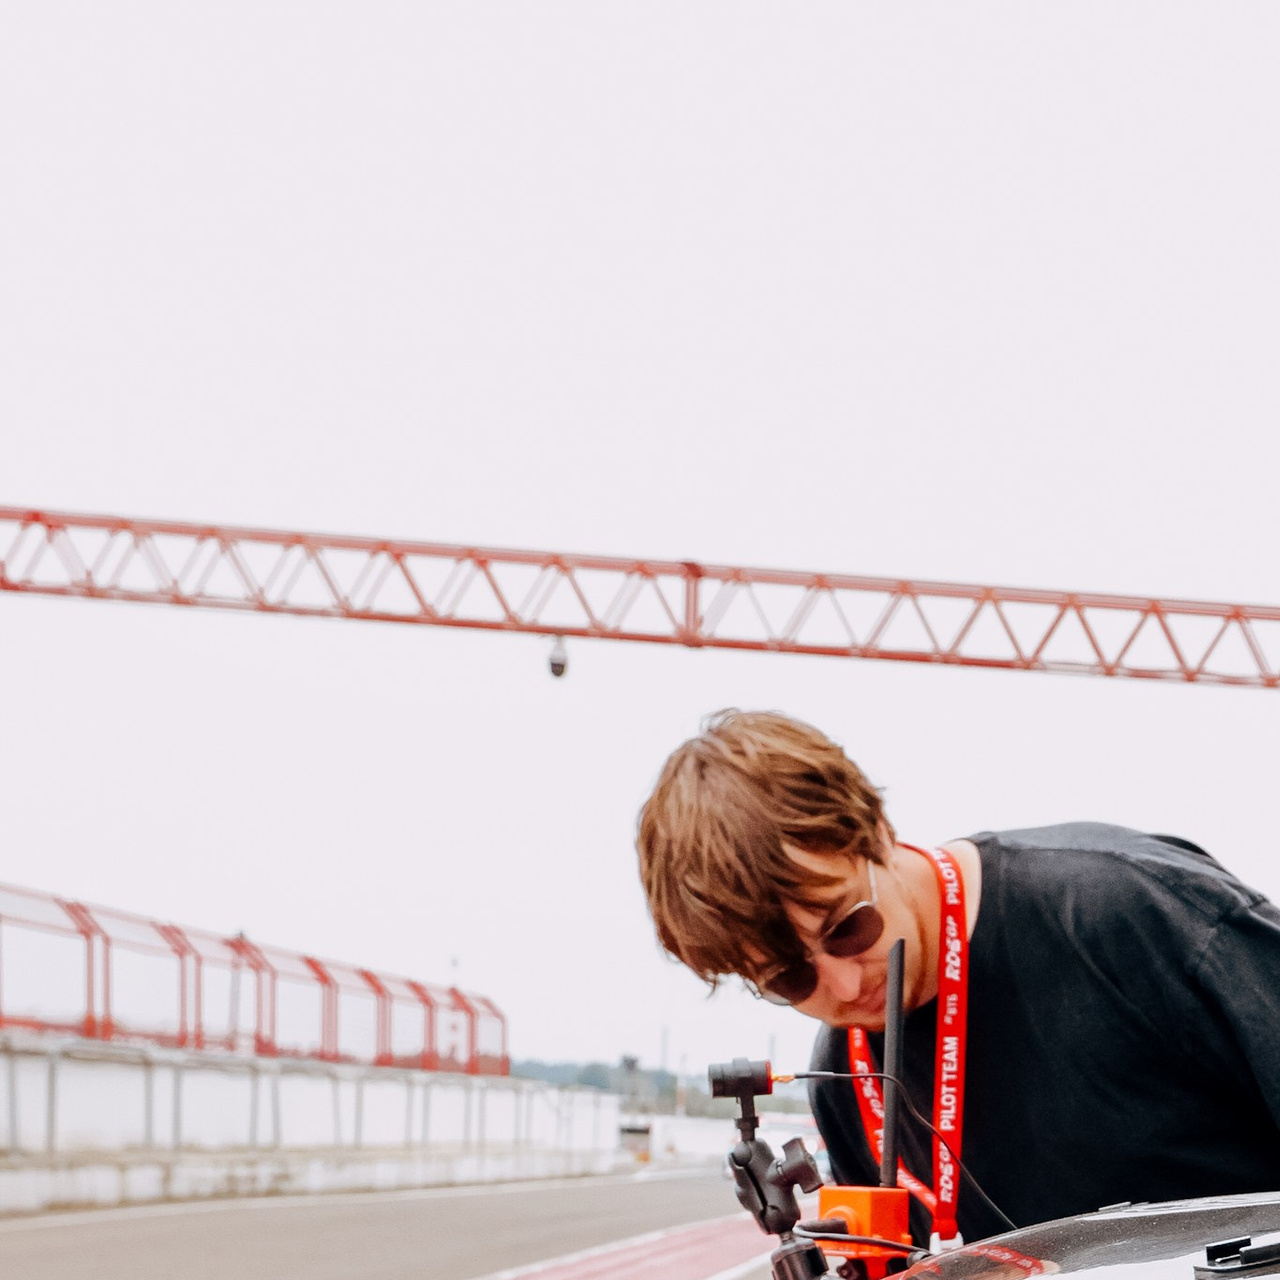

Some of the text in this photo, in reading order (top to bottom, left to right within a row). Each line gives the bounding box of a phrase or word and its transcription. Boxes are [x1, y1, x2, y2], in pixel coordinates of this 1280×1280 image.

[938, 860, 961, 905] PILOT
[940, 1036, 959, 1131] PILOT TEAM
